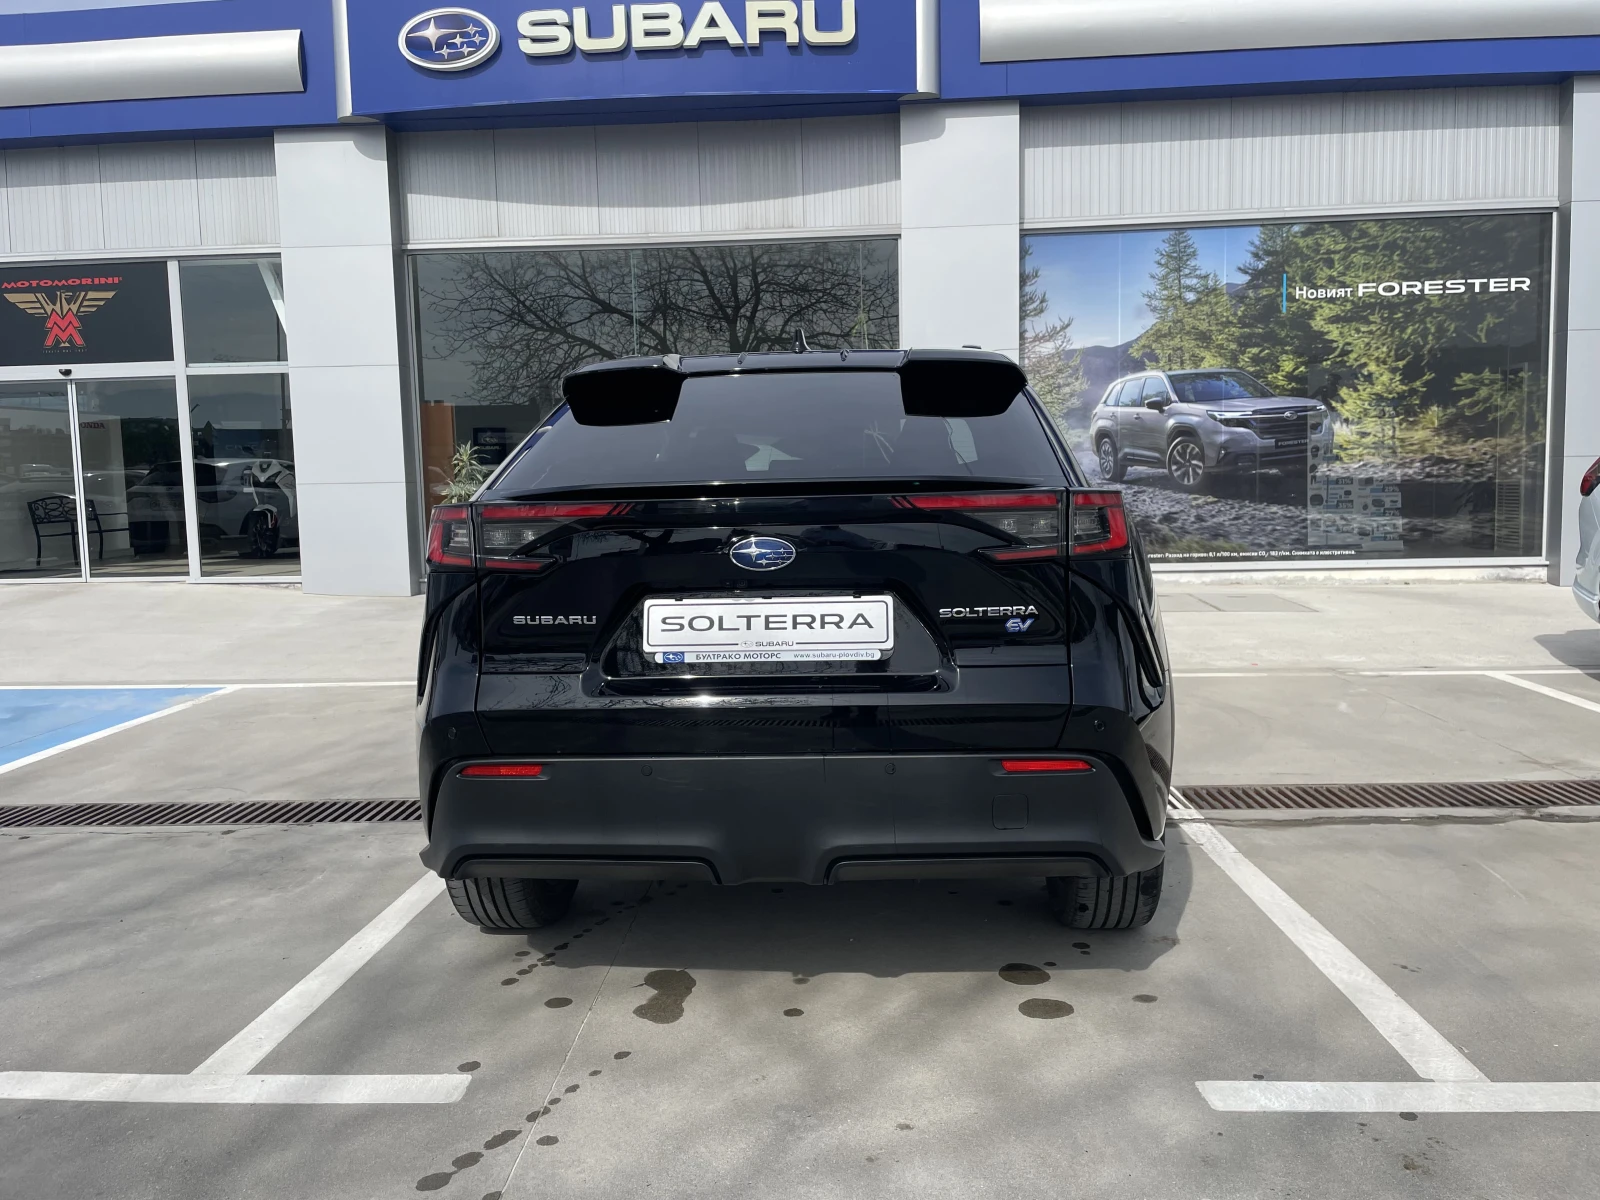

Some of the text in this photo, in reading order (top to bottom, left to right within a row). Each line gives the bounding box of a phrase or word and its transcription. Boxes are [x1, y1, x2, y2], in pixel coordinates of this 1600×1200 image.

[517, 0, 856, 57] SUBARU
[1295, 277, 1531, 300] Новият FORESTER
[80, 422, 106, 430] ONDA
[939, 605, 1039, 618] SOLTERRA
[513, 615, 597, 625] SUBARU
[660, 612, 874, 632] SOLTERRA
[1005, 618, 1035, 632] EV
[696, 652, 741, 660] БУЛТРАКО
[793, 650, 875, 659] www.subaru-plovdiv.bg
